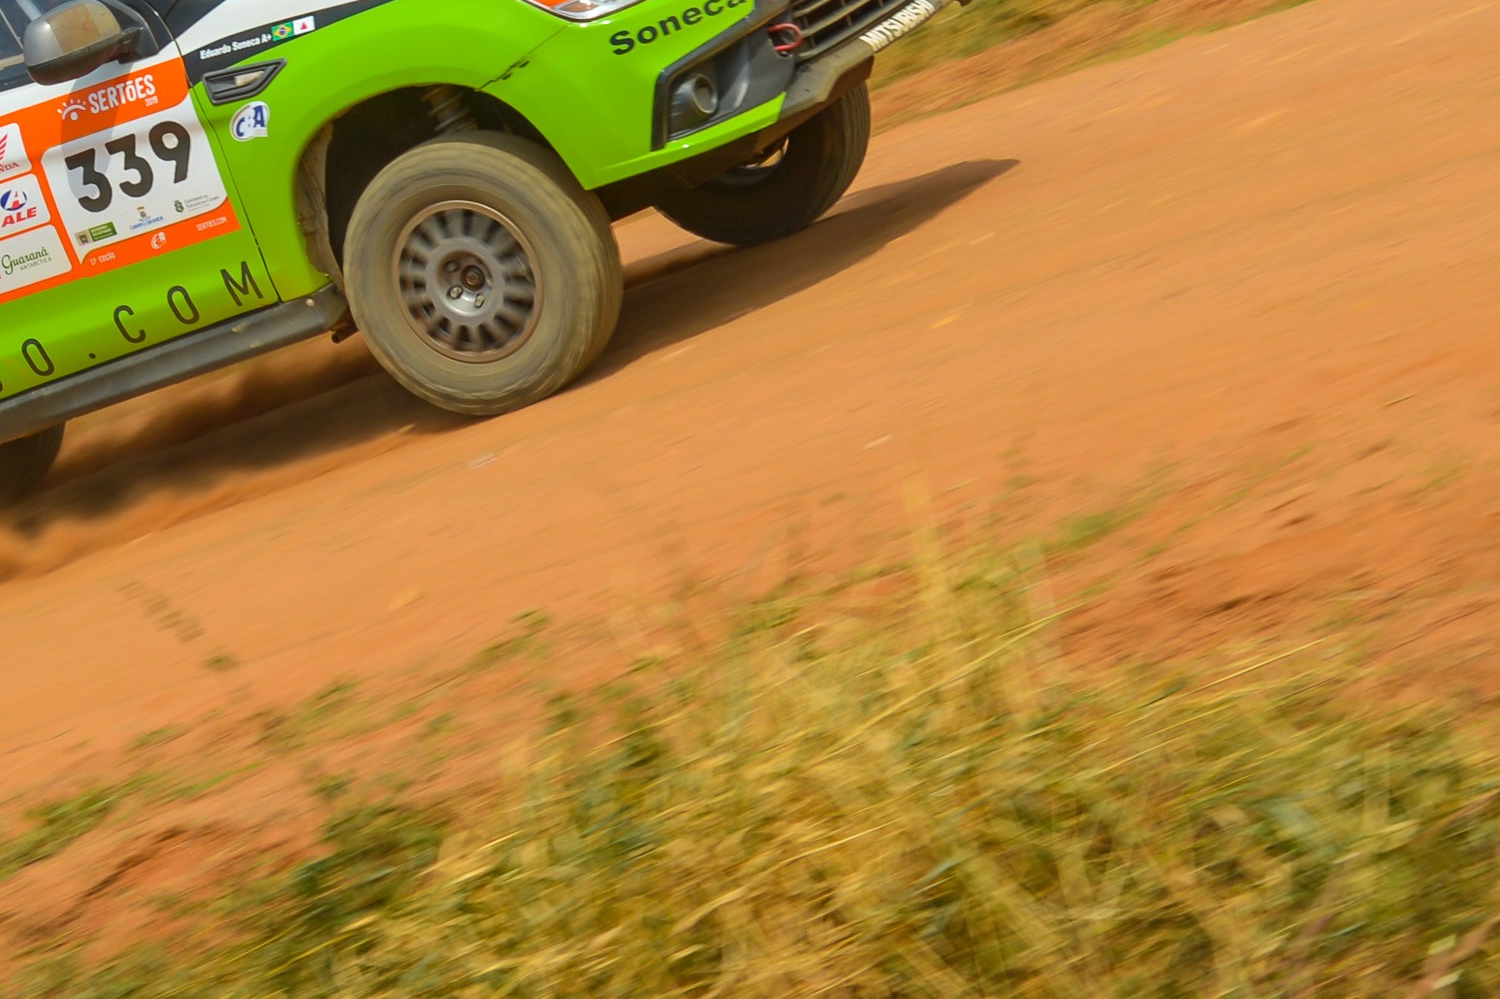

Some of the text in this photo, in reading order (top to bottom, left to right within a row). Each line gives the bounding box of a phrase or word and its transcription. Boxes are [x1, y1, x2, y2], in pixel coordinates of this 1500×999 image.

[200, 40, 232, 60] Eduardo
[232, 36, 261, 52] Soneca
[88, 74, 156, 114] SERTÕES
[65, 121, 191, 213] 339
[2, 206, 37, 228] ALE
[1, 247, 49, 275] Guaraná
